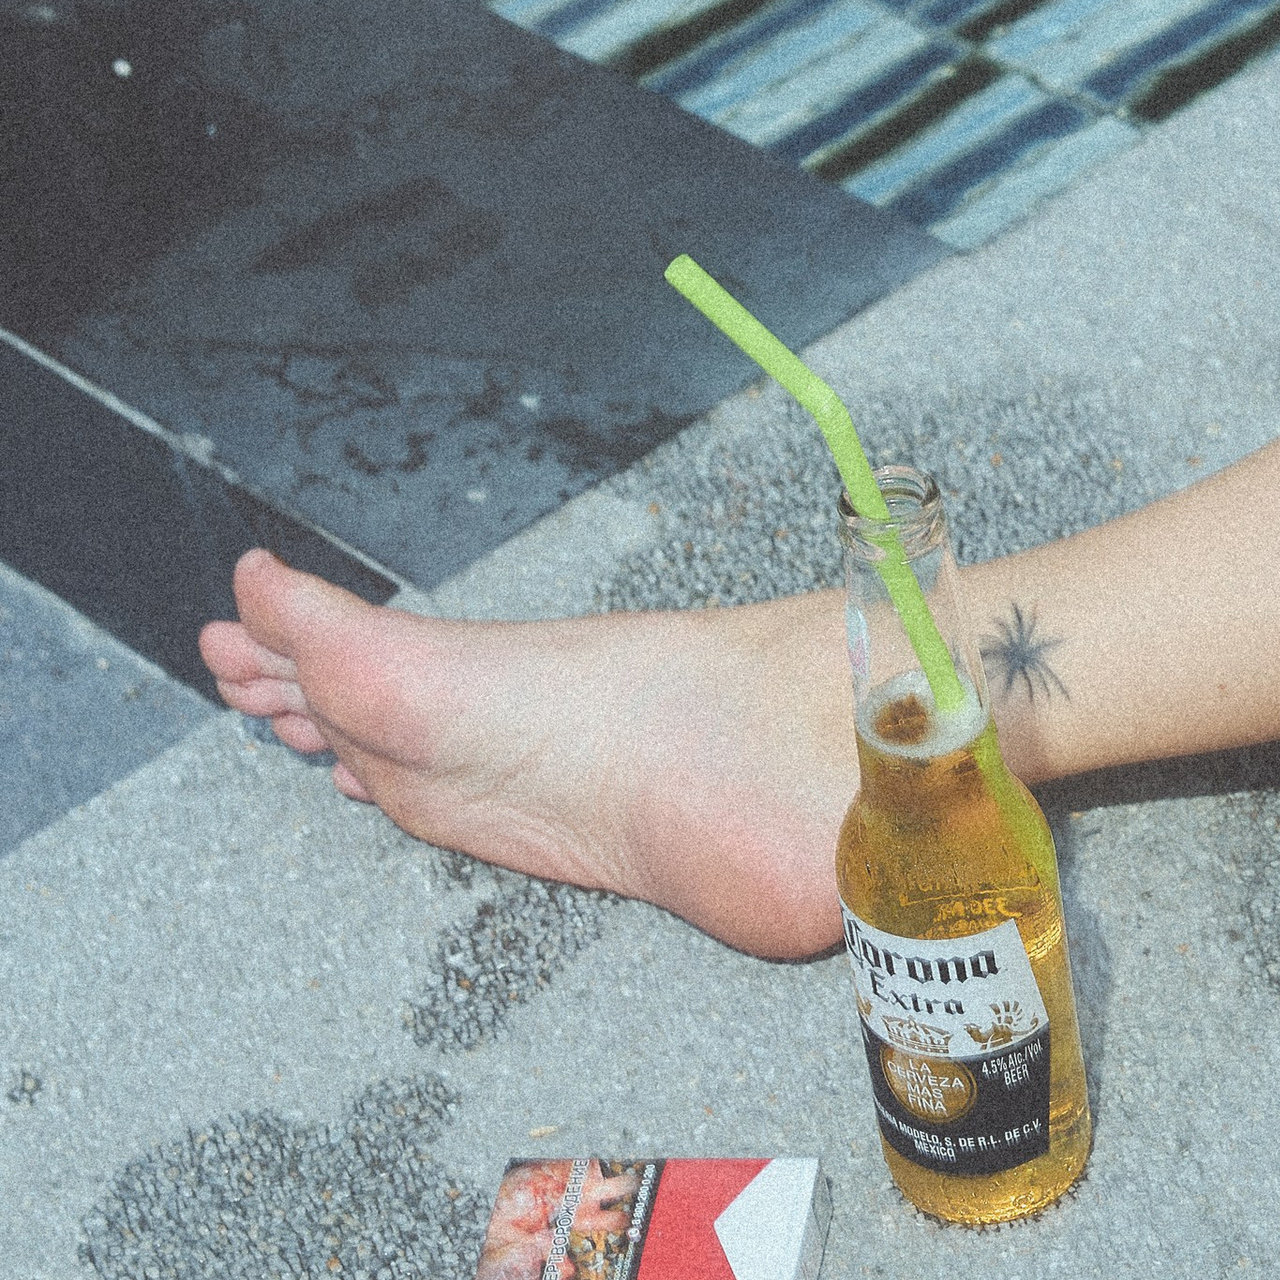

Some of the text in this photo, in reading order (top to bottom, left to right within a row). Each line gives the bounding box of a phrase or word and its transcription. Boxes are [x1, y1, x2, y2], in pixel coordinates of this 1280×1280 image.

[843, 919, 1003, 985] Corona
[869, 967, 966, 1015] Extra
[887, 1060, 965, 1089] CERVEZA
[909, 1058, 932, 1075] LA
[981, 1056, 1008, 1076] 4.5%
[1004, 1063, 1029, 1086] BEER
[906, 1081, 944, 1099] MAS
[908, 1093, 948, 1113] FINA
[944, 1136, 957, 1147] S.
[958, 1137, 976, 1148] DE
[978, 1135, 1002, 1147] R.L.
[1004, 1128, 1021, 1141] DE
[1023, 1118, 1042, 1135] C.V.
[913, 1139, 956, 1158] MEXICO
